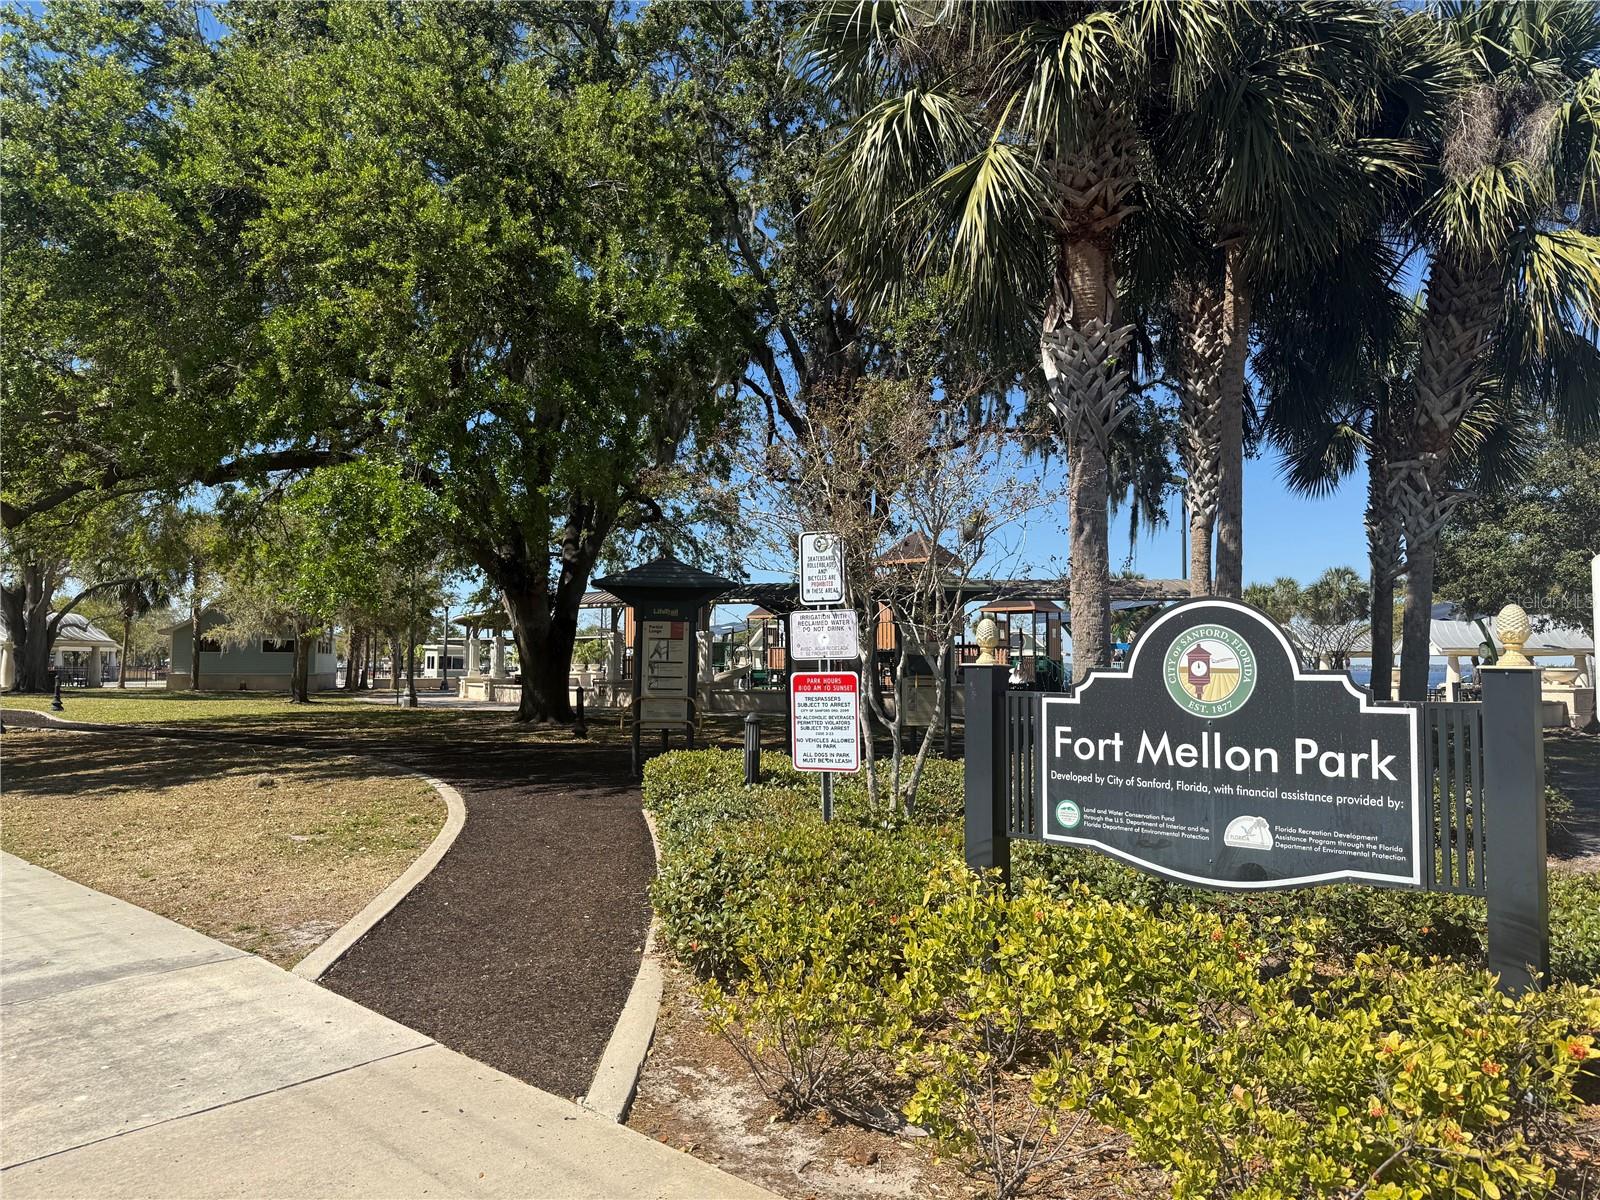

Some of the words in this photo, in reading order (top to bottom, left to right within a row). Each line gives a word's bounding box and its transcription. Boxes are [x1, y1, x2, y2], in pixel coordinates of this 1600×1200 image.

[1167, 658, 1177, 684] CITY
[1172, 645, 1181, 657] OF
[1180, 628, 1231, 646] SANFORD,
[1230, 638, 1252, 683] FLORIDA
[1187, 700, 1209, 713] EST.
[1211, 700, 1233, 713] 1877
[1055, 725, 1124, 762] Fort
[1136, 729, 1279, 773] Mellon
[1295, 737, 1398, 781] Park
[1050, 770, 1093, 784] Developed
[1095, 773, 1105, 786] by
[1106, 774, 1124, 788] City
[1125, 776, 1135, 787] of
[1136, 777, 1174, 791] Sanford,
[1176, 780, 1211, 795] Florida,
[1213, 784, 1234, 795] with
[1235, 785, 1278, 799] financial
[1280, 789, 1333, 803] assistance
[1335, 795, 1384, 810] provided
[1387, 796, 1404, 811] by:
[1083, 813, 1104, 822] through
[1105, 815, 1114, 823] the
[1126, 818, 1158, 828] Department
[1166, 823, 1187, 831] Interior
[1124, 811, 1160, 820] Conservation
[1161, 814, 1176, 822] Fund
[1083, 820, 1102, 828] Florida
[1102, 823, 1134, 832] Department
[1141, 827, 1181, 838] Environmental
[1181, 831, 1210, 841] Protection
[1274, 826, 1297, 834] Florida
[1298, 828, 1332, 838] Recreation
[1333, 831, 1379, 842] Development
[1274, 834, 1307, 843] Assistance
[1308, 836, 1337, 846] Program
[1337, 839, 1365, 849] through
[1366, 842, 1377, 850] the
[1379, 844, 1404, 853] Florida
[1274, 841, 1312, 852] Department
[1322, 846, 1370, 858] Environmental
[1371, 851, 1407, 862] Protection
